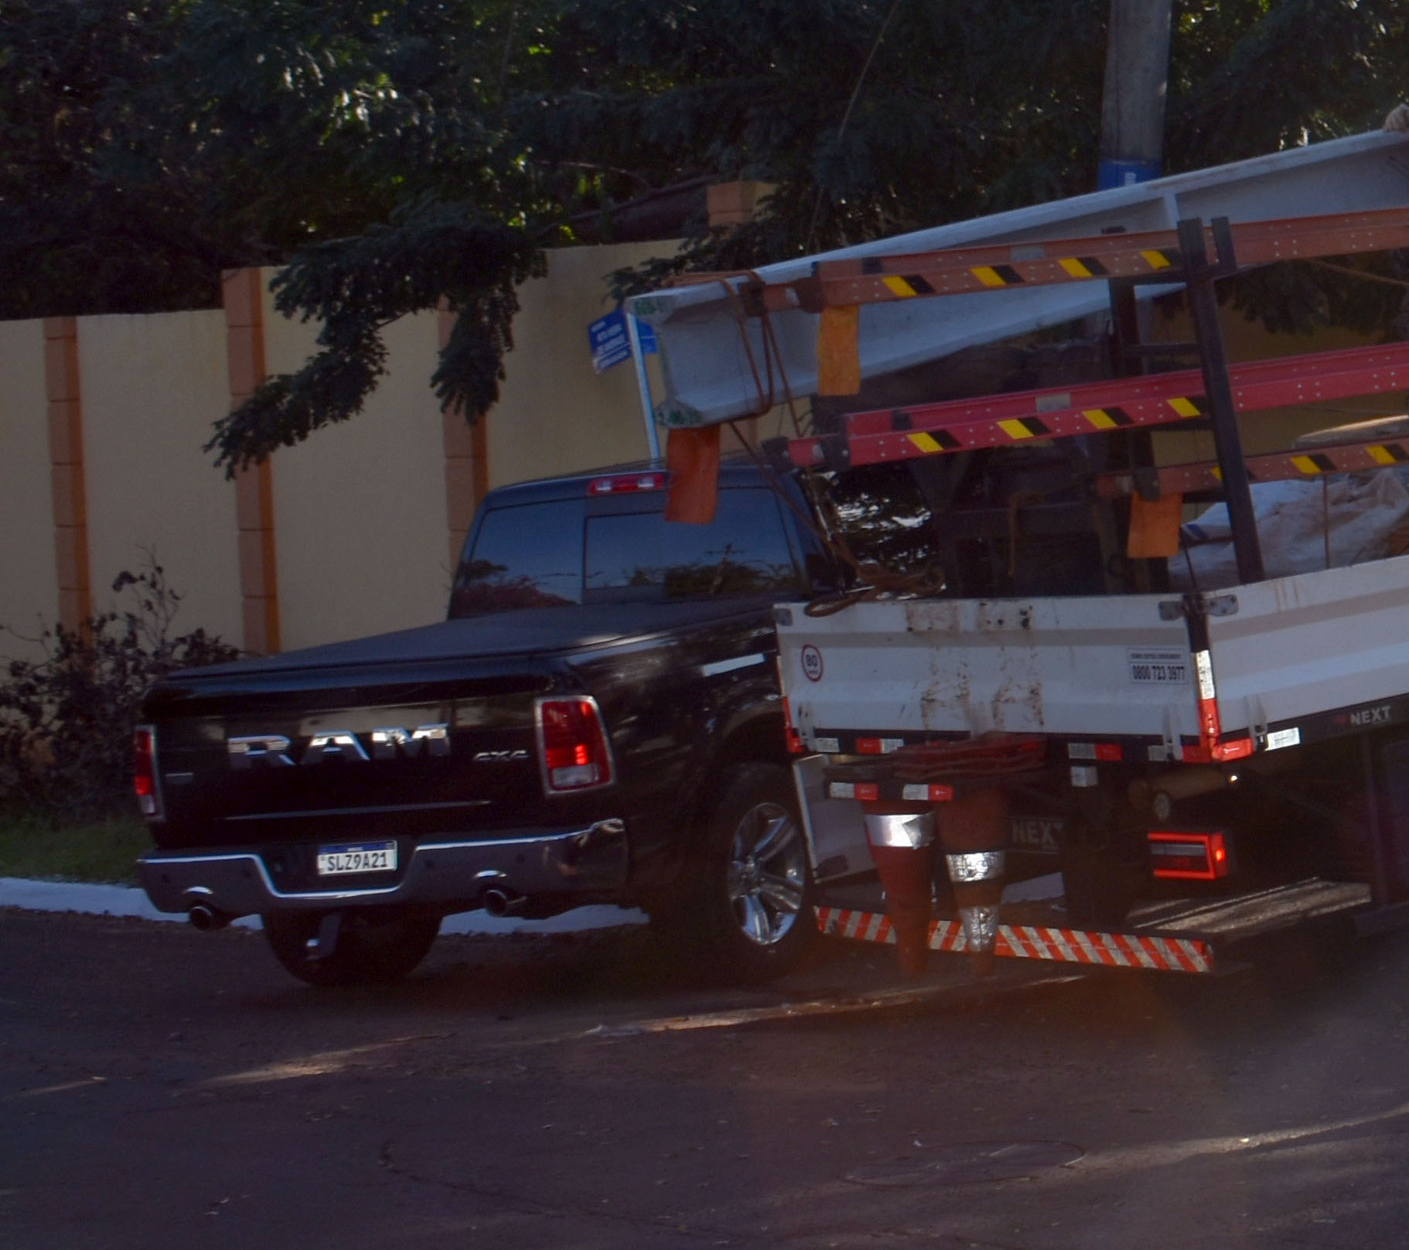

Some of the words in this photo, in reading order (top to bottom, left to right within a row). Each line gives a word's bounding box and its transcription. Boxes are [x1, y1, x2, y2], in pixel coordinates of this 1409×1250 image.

[806, 654, 818, 667] 80
[1350, 705, 1391, 725] NEXT
[228, 723, 449, 769] RAM
[327, 852, 388, 871] SLZ9A21
